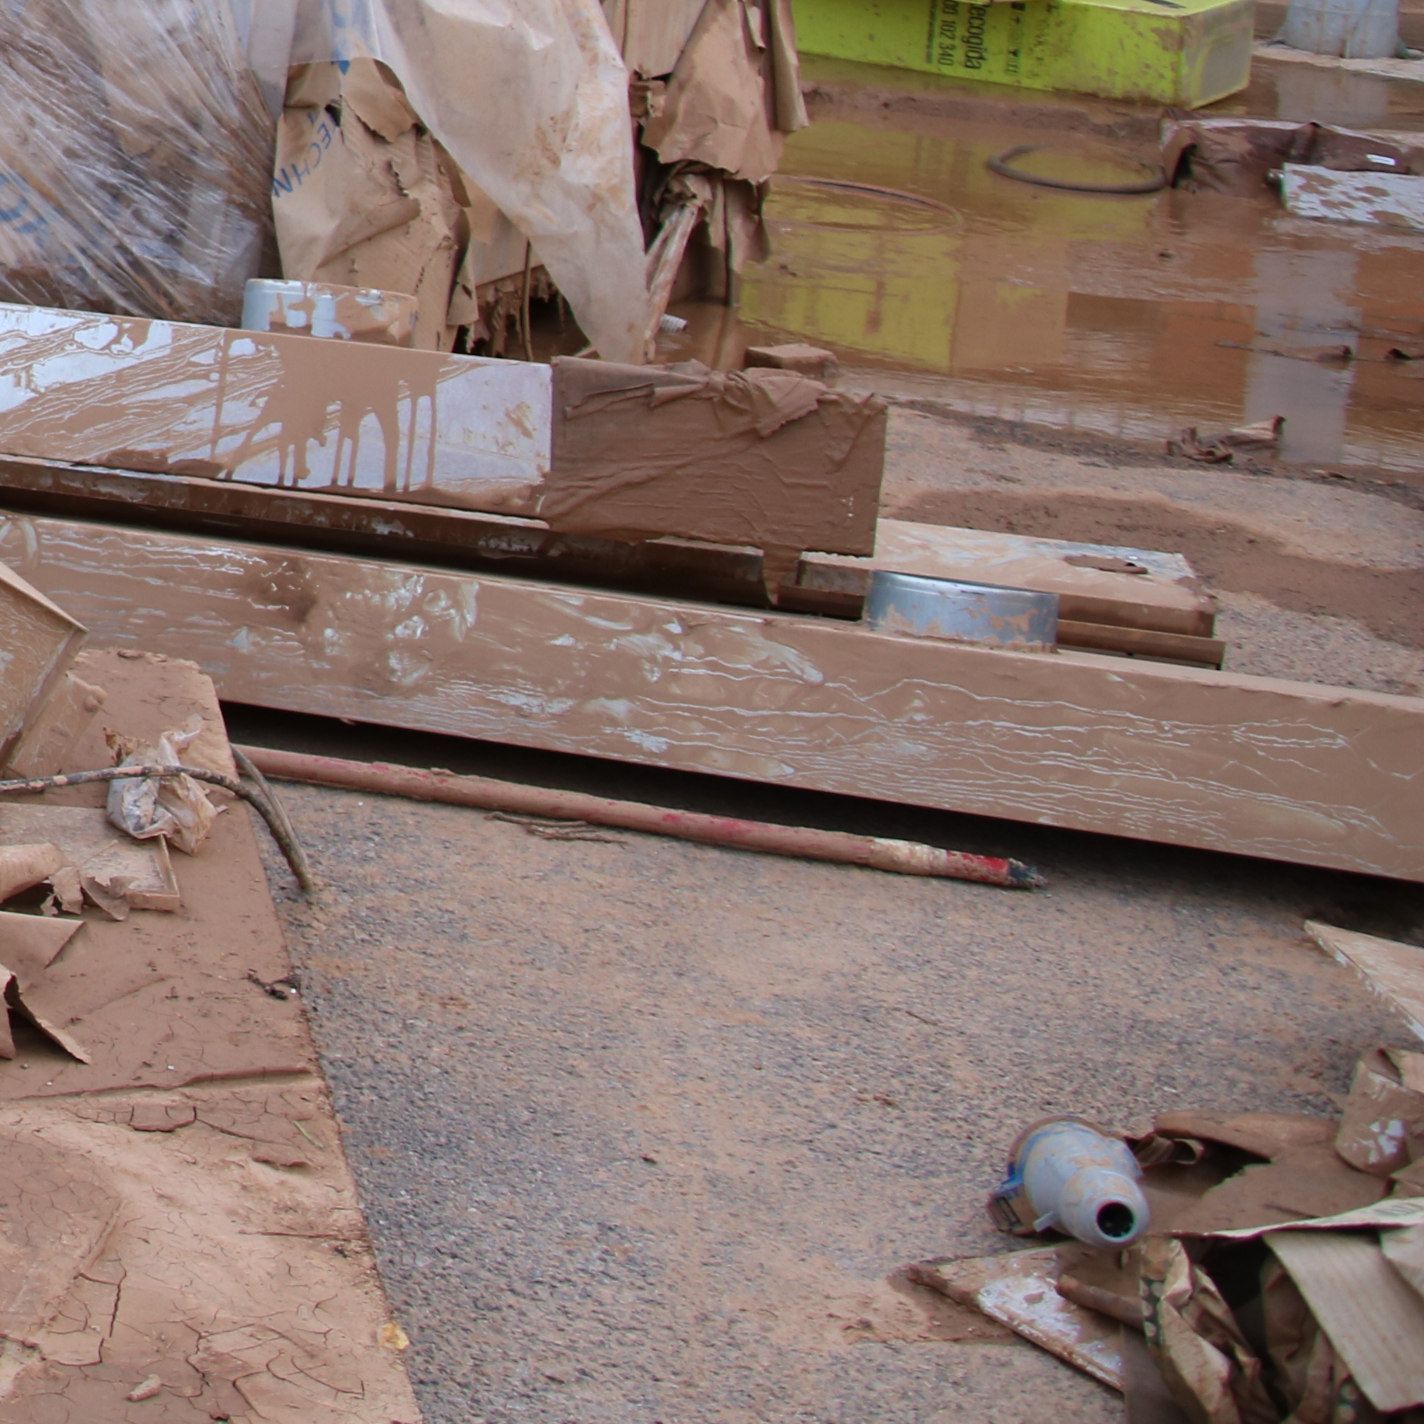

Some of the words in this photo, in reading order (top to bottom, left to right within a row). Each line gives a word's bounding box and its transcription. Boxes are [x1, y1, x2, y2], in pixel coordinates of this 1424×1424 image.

[940, 19, 957, 41] 102
[961, 4, 991, 70] ecogida
[938, 42, 956, 66] 340
